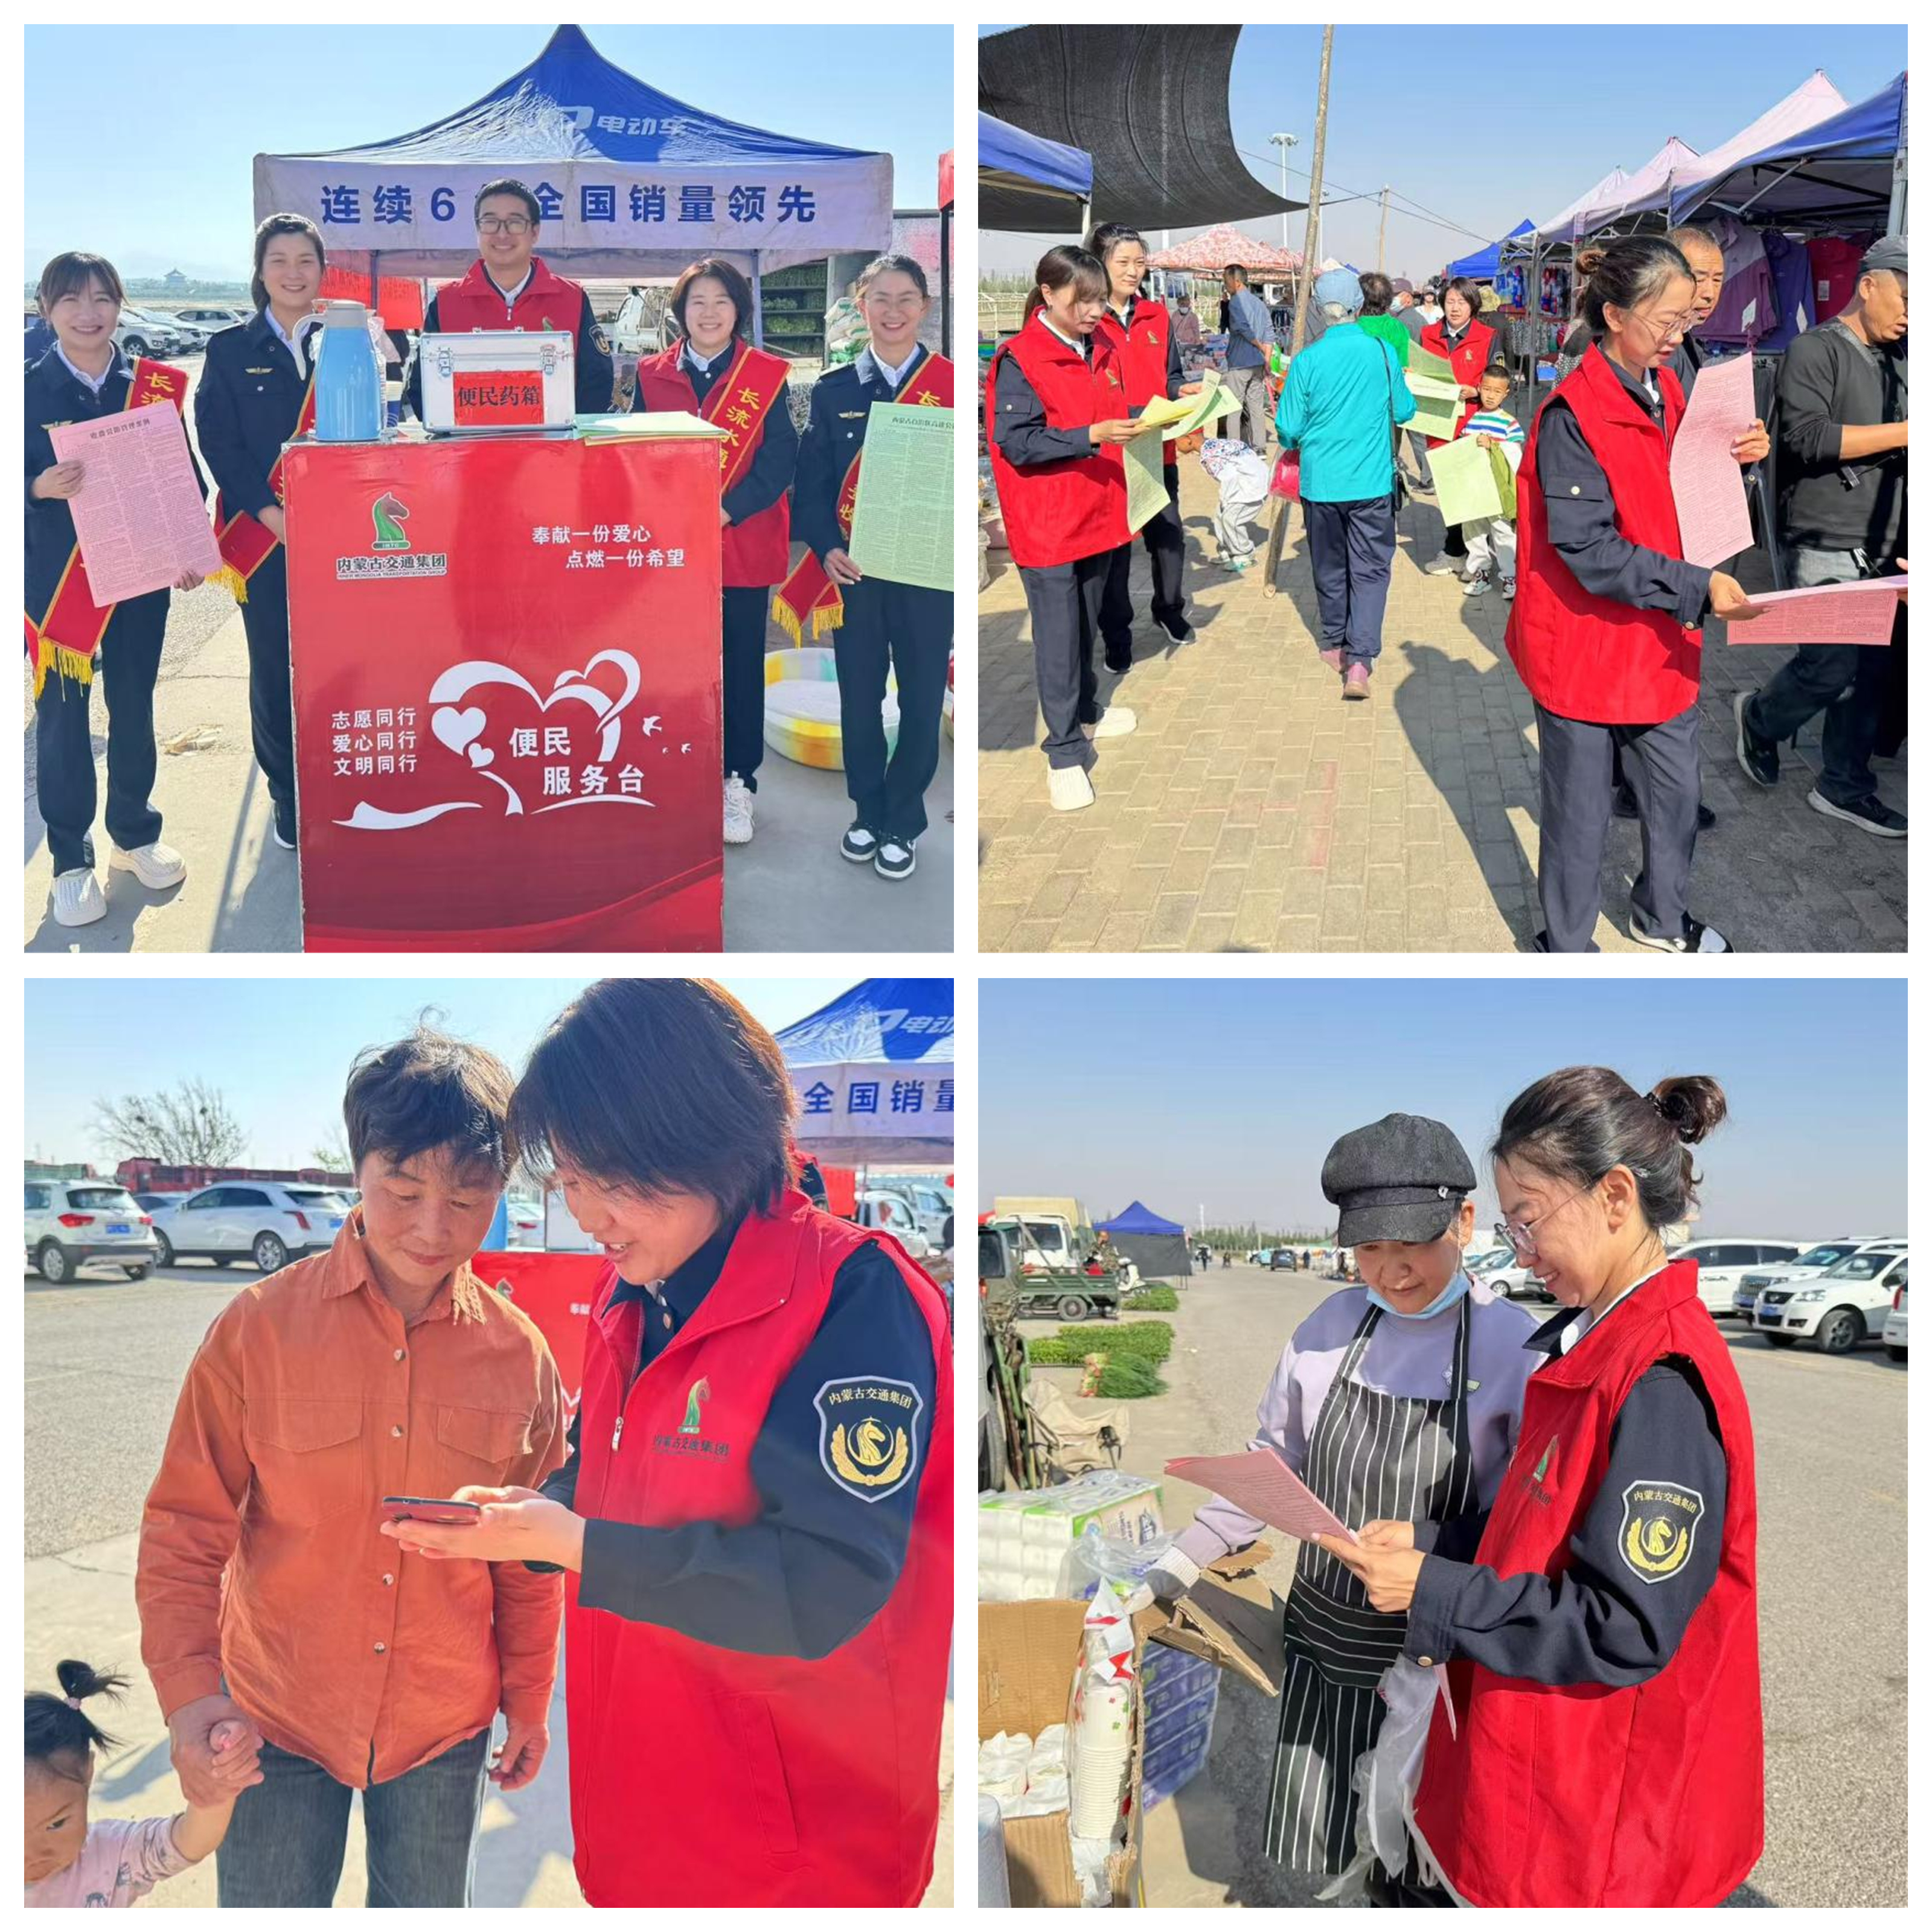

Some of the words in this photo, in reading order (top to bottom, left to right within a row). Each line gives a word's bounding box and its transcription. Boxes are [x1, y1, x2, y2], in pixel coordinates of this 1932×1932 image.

[321, 182, 816, 224] 连续6全国销量领先
[458, 385, 539, 407] 便民药箱
[532, 524, 651, 545] 奉献一份爱心
[337, 554, 446, 571] 内蒙古交通集团
[566, 549, 685, 569] 点燃一份希望
[331, 708, 417, 729] 志愿同行
[332, 731, 417, 753] 爱心同行
[509, 727, 572, 758] 便民
[333, 754, 417, 776] 文明同行
[543, 764, 645, 795] 服务台
[828, 1387, 913, 1409] 内蒙古交通集团
[1634, 1489, 1697, 1514] 内蒙古交通集团
